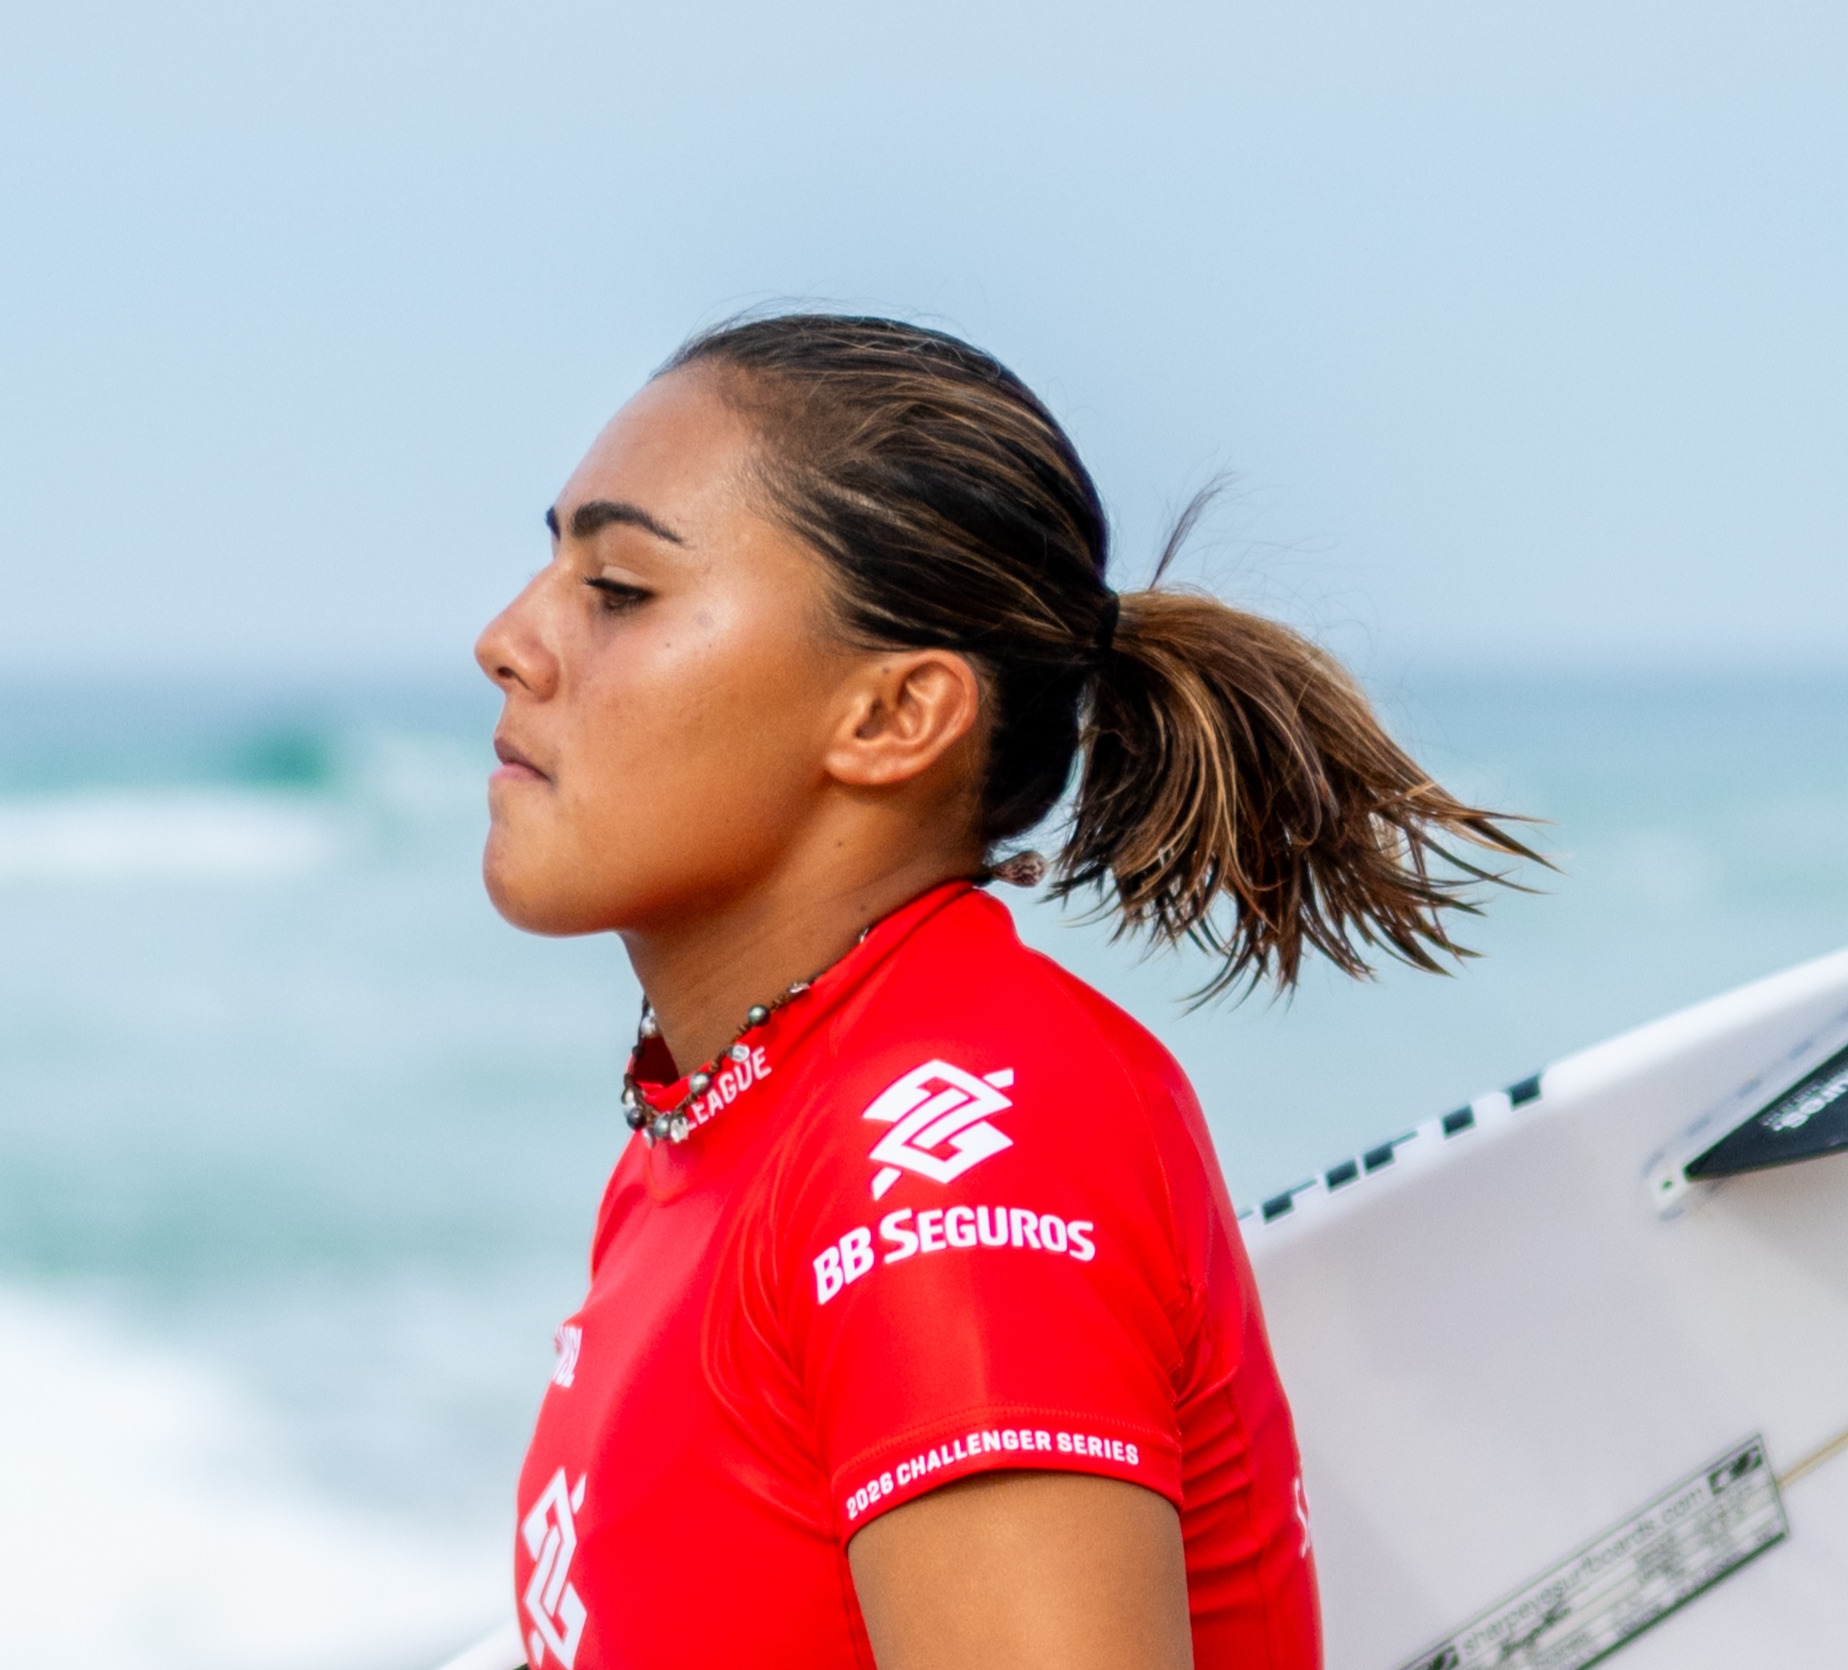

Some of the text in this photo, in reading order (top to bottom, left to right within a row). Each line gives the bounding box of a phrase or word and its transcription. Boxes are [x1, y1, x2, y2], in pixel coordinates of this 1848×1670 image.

[812, 1205, 1096, 1305] BB SEGUROS
[845, 1429, 1140, 1520] 2026 CHALLENGER SERIES
